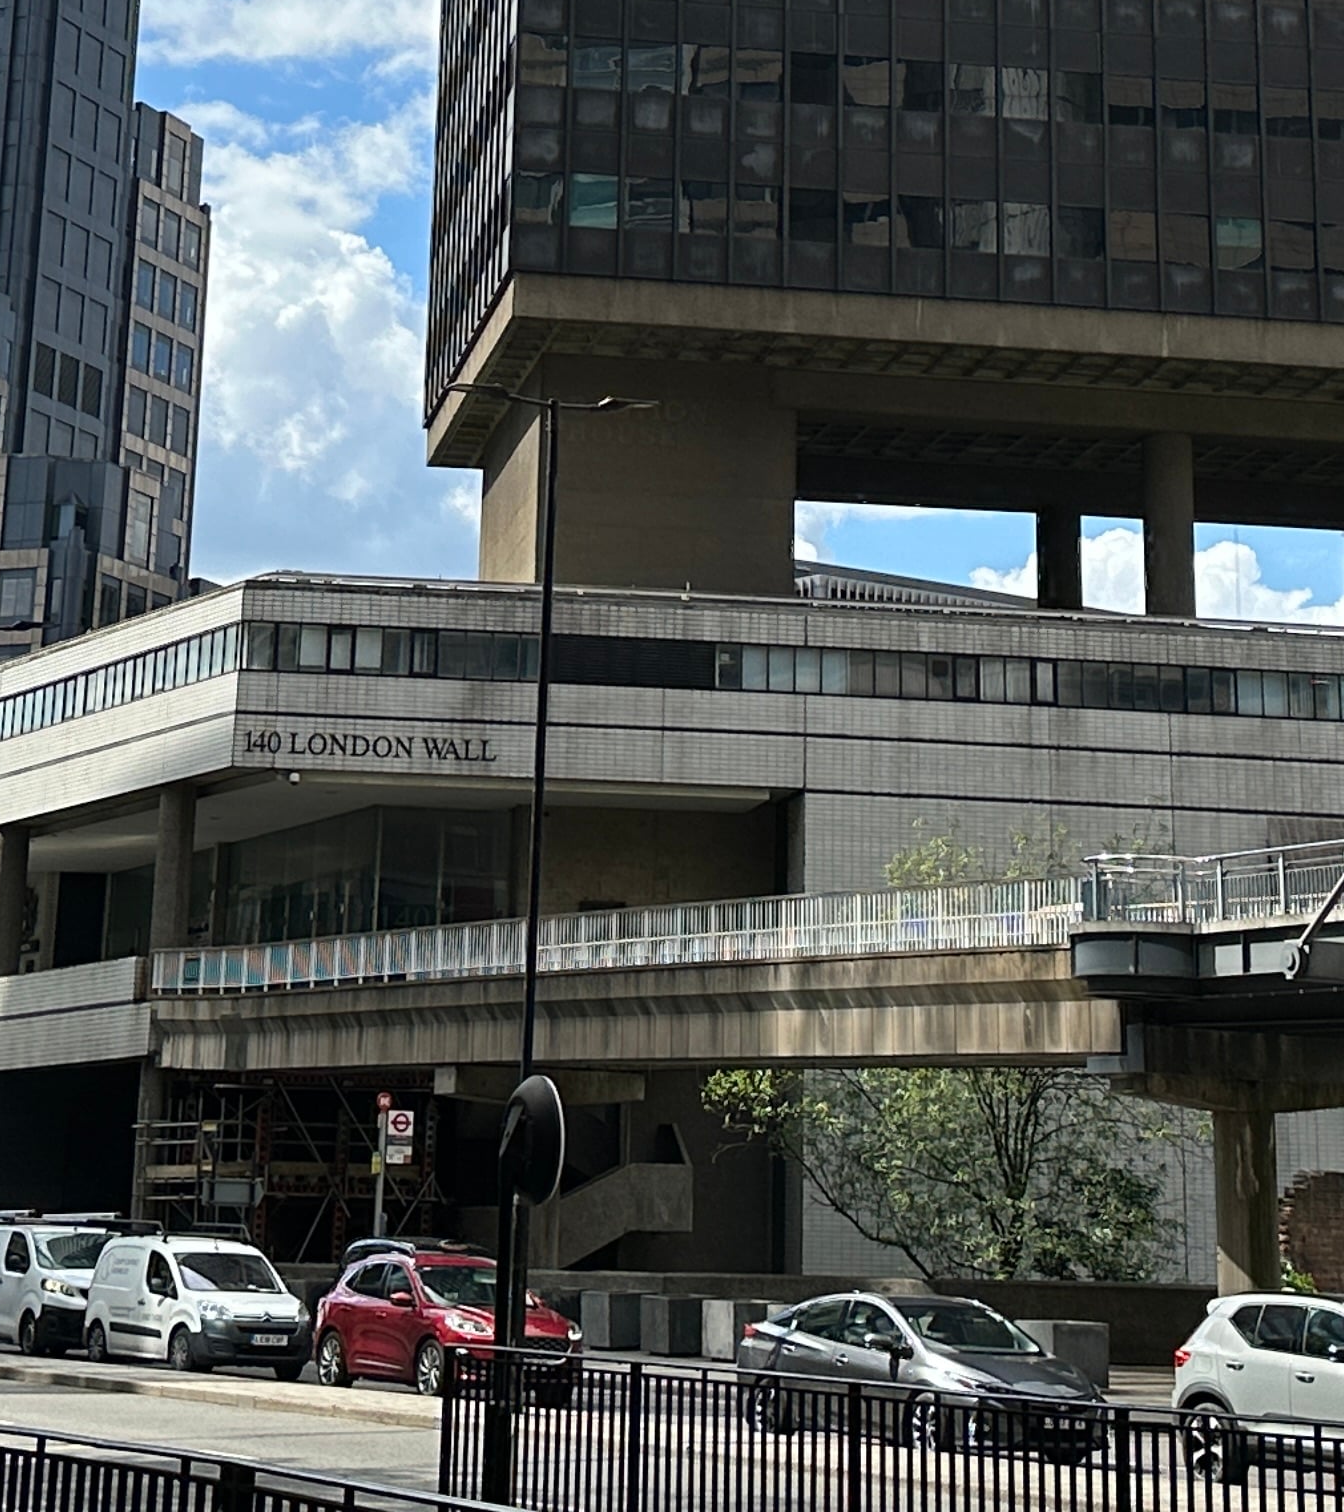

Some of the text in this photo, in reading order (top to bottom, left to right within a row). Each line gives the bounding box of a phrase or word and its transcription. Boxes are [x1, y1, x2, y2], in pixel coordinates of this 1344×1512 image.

[243, 729, 497, 762] 140 LONDON WALL
